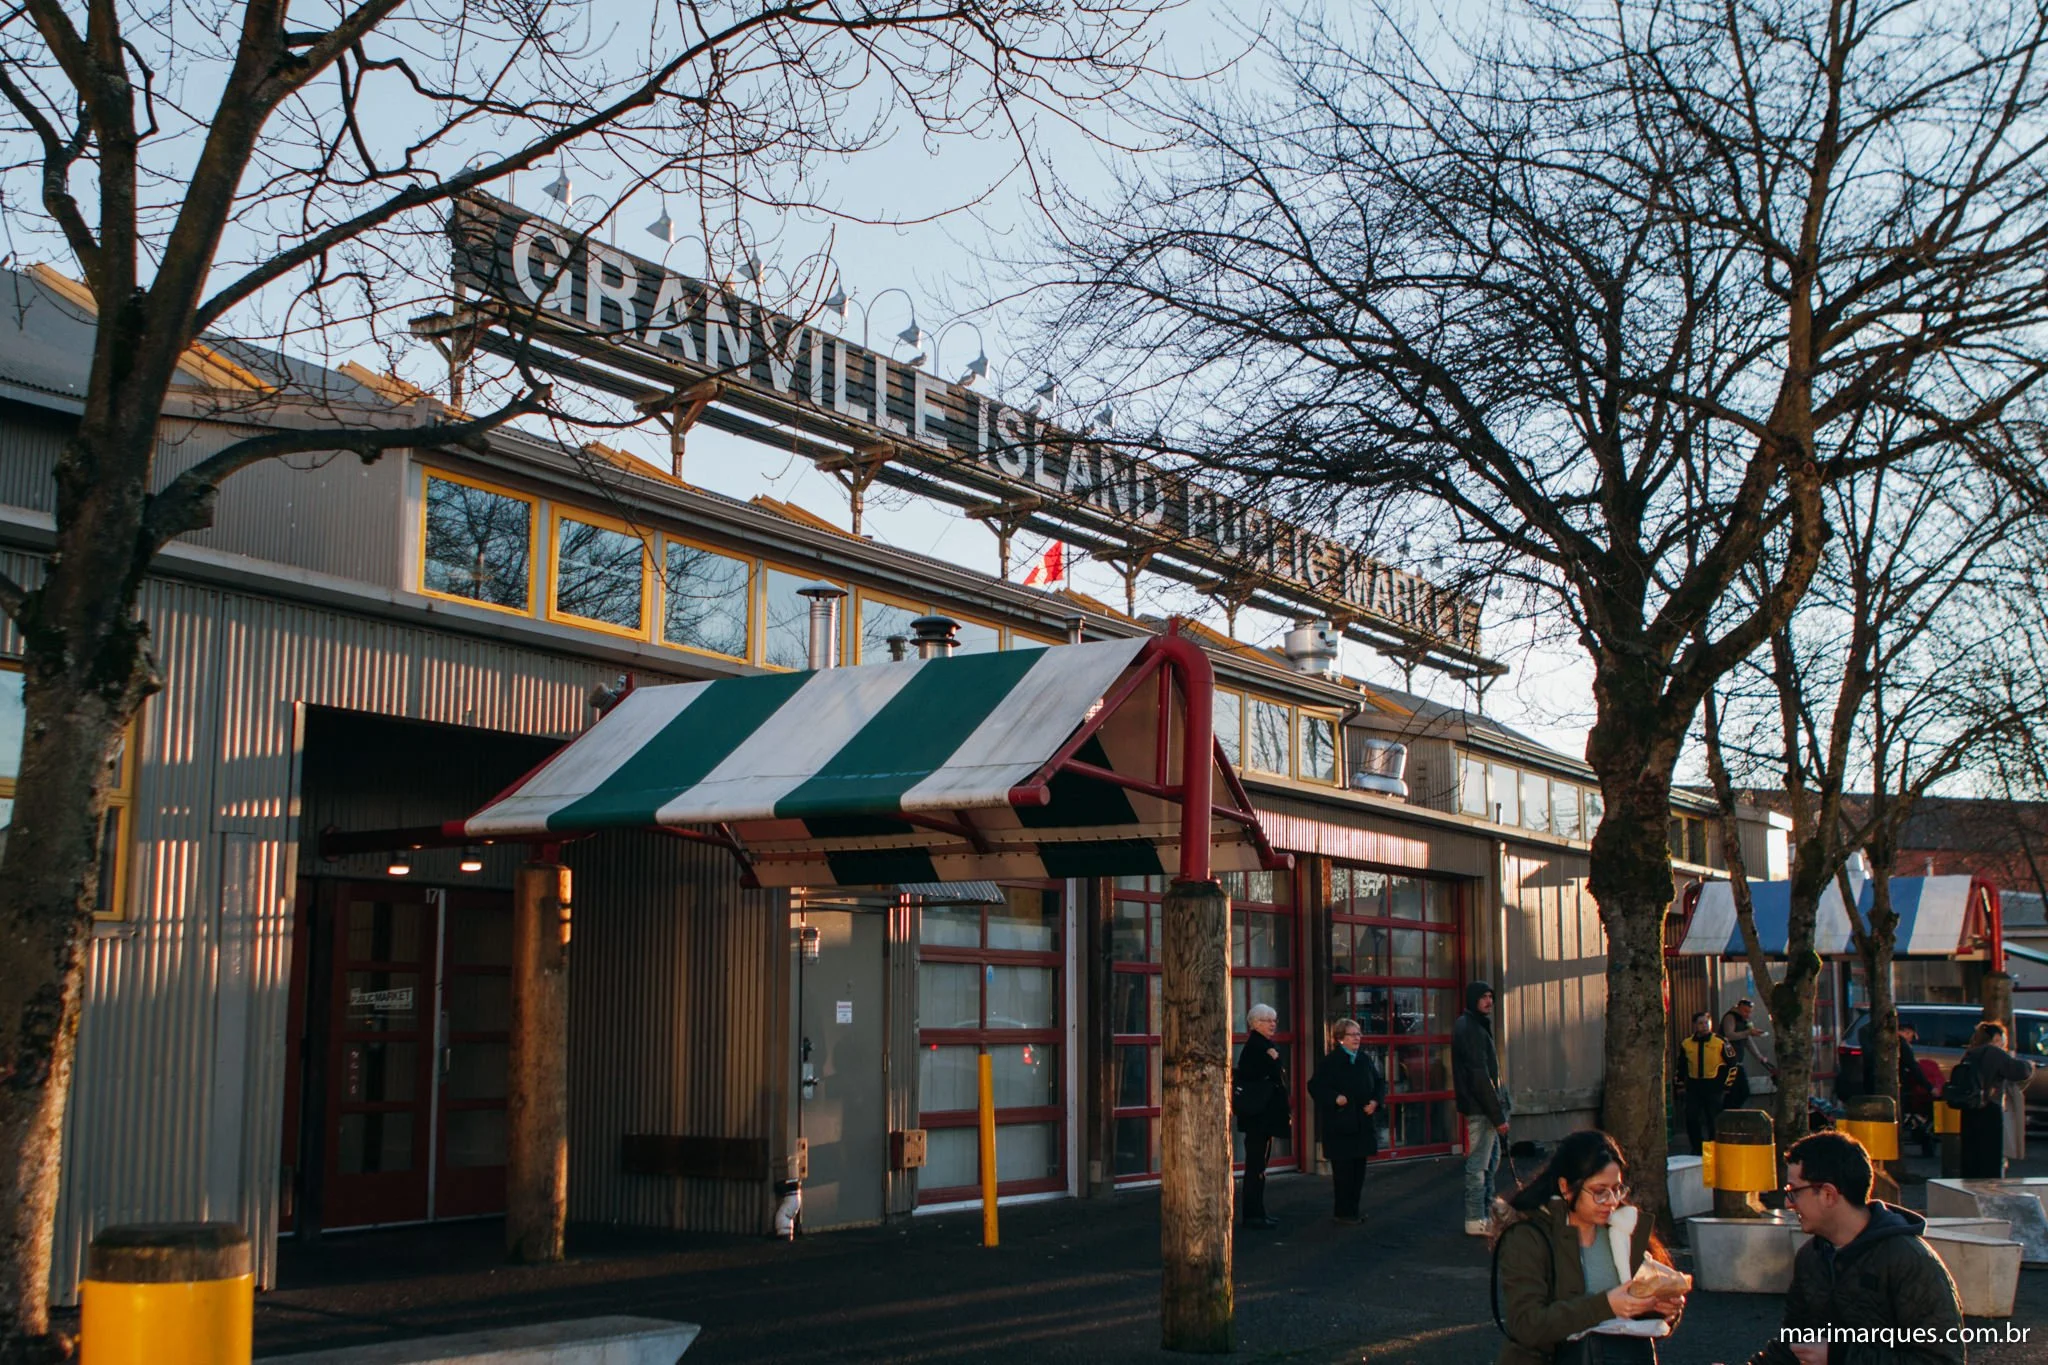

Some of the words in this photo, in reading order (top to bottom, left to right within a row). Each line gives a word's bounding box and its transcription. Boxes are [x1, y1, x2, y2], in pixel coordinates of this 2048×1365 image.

[512, 217, 948, 450] GRANVILLE
[978, 399, 1165, 525] ISLAND
[425, 888, 438, 904] 17
[375, 990, 410, 1002] MARKET
